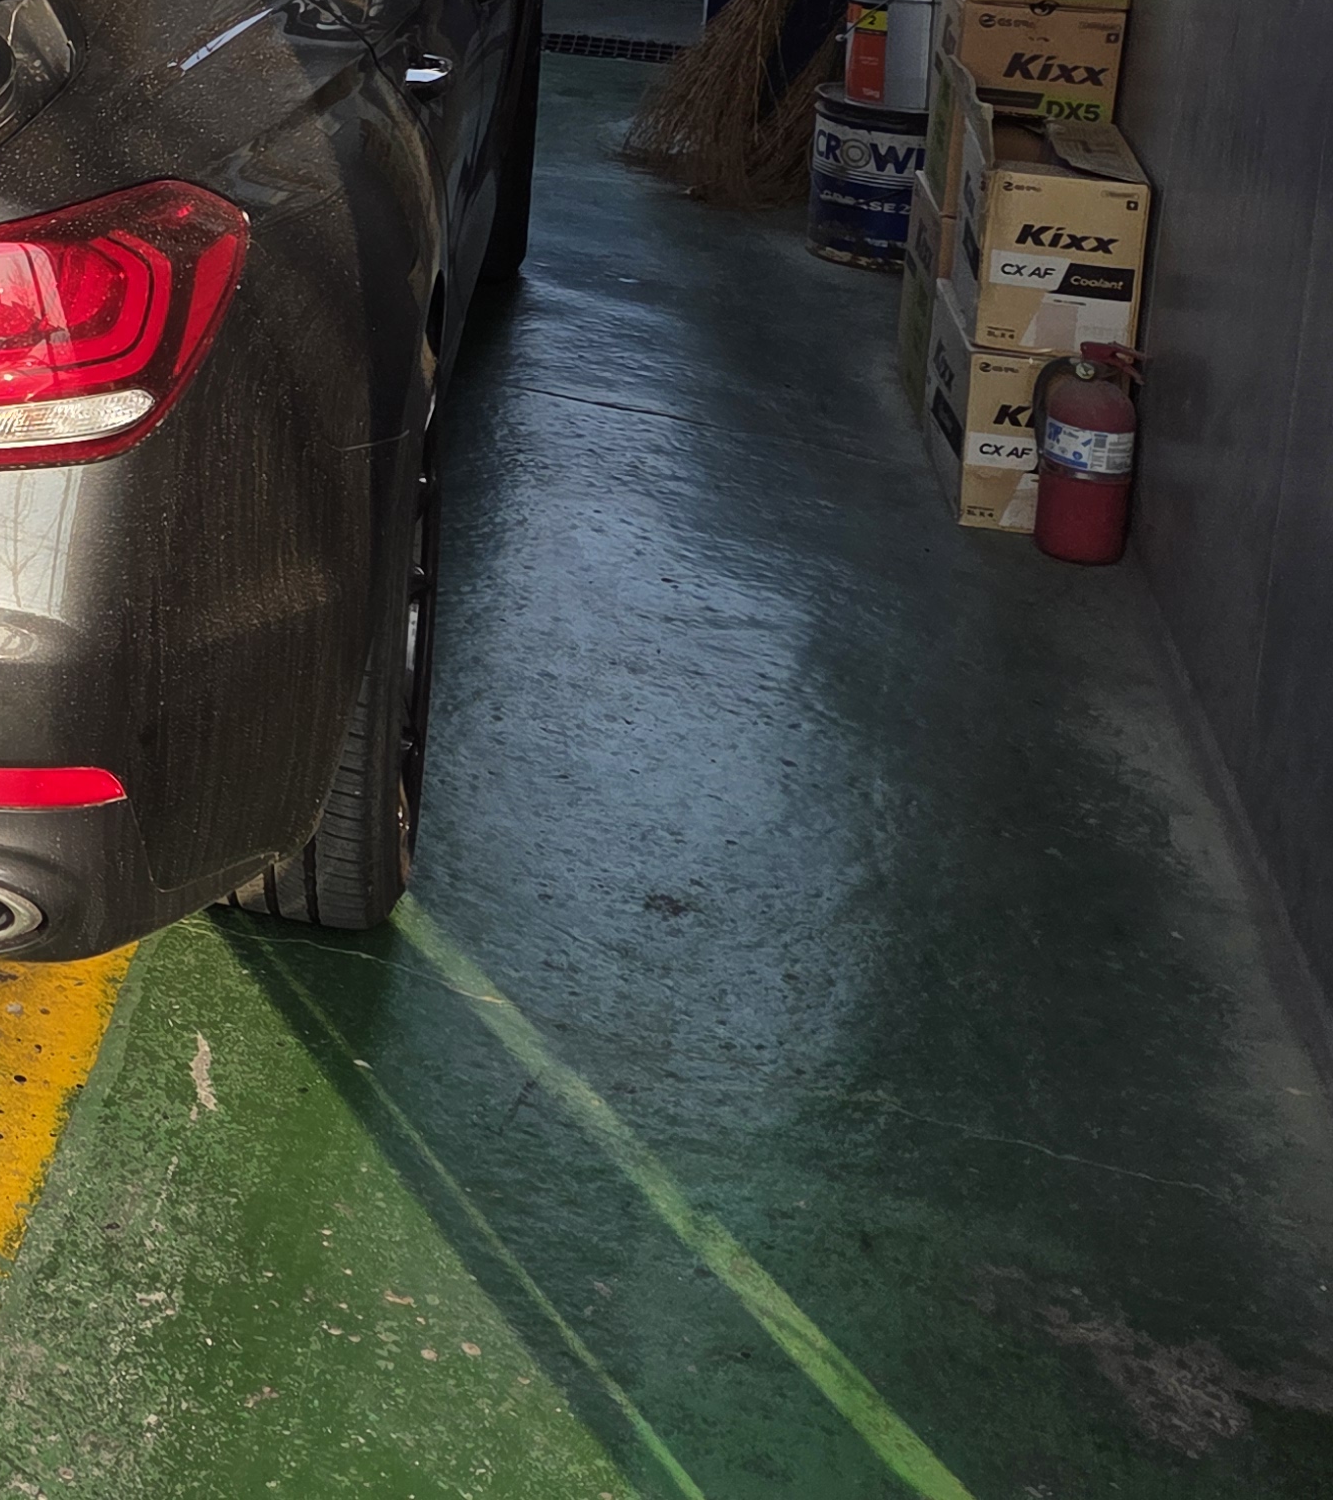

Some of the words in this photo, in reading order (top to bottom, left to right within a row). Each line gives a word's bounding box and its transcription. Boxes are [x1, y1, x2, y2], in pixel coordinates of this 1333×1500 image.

[868, 14, 877, 25] 2
[1003, 52, 1109, 86] Kixx
[1046, 100, 1101, 122] DX5
[1015, 224, 1119, 255] Kixx
[1001, 263, 1027, 277] CX
[1028, 265, 1056, 279] AF
[1069, 274, 1125, 290] Coolant
[979, 443, 1005, 457] CX
[1005, 444, 1033, 458] AF
